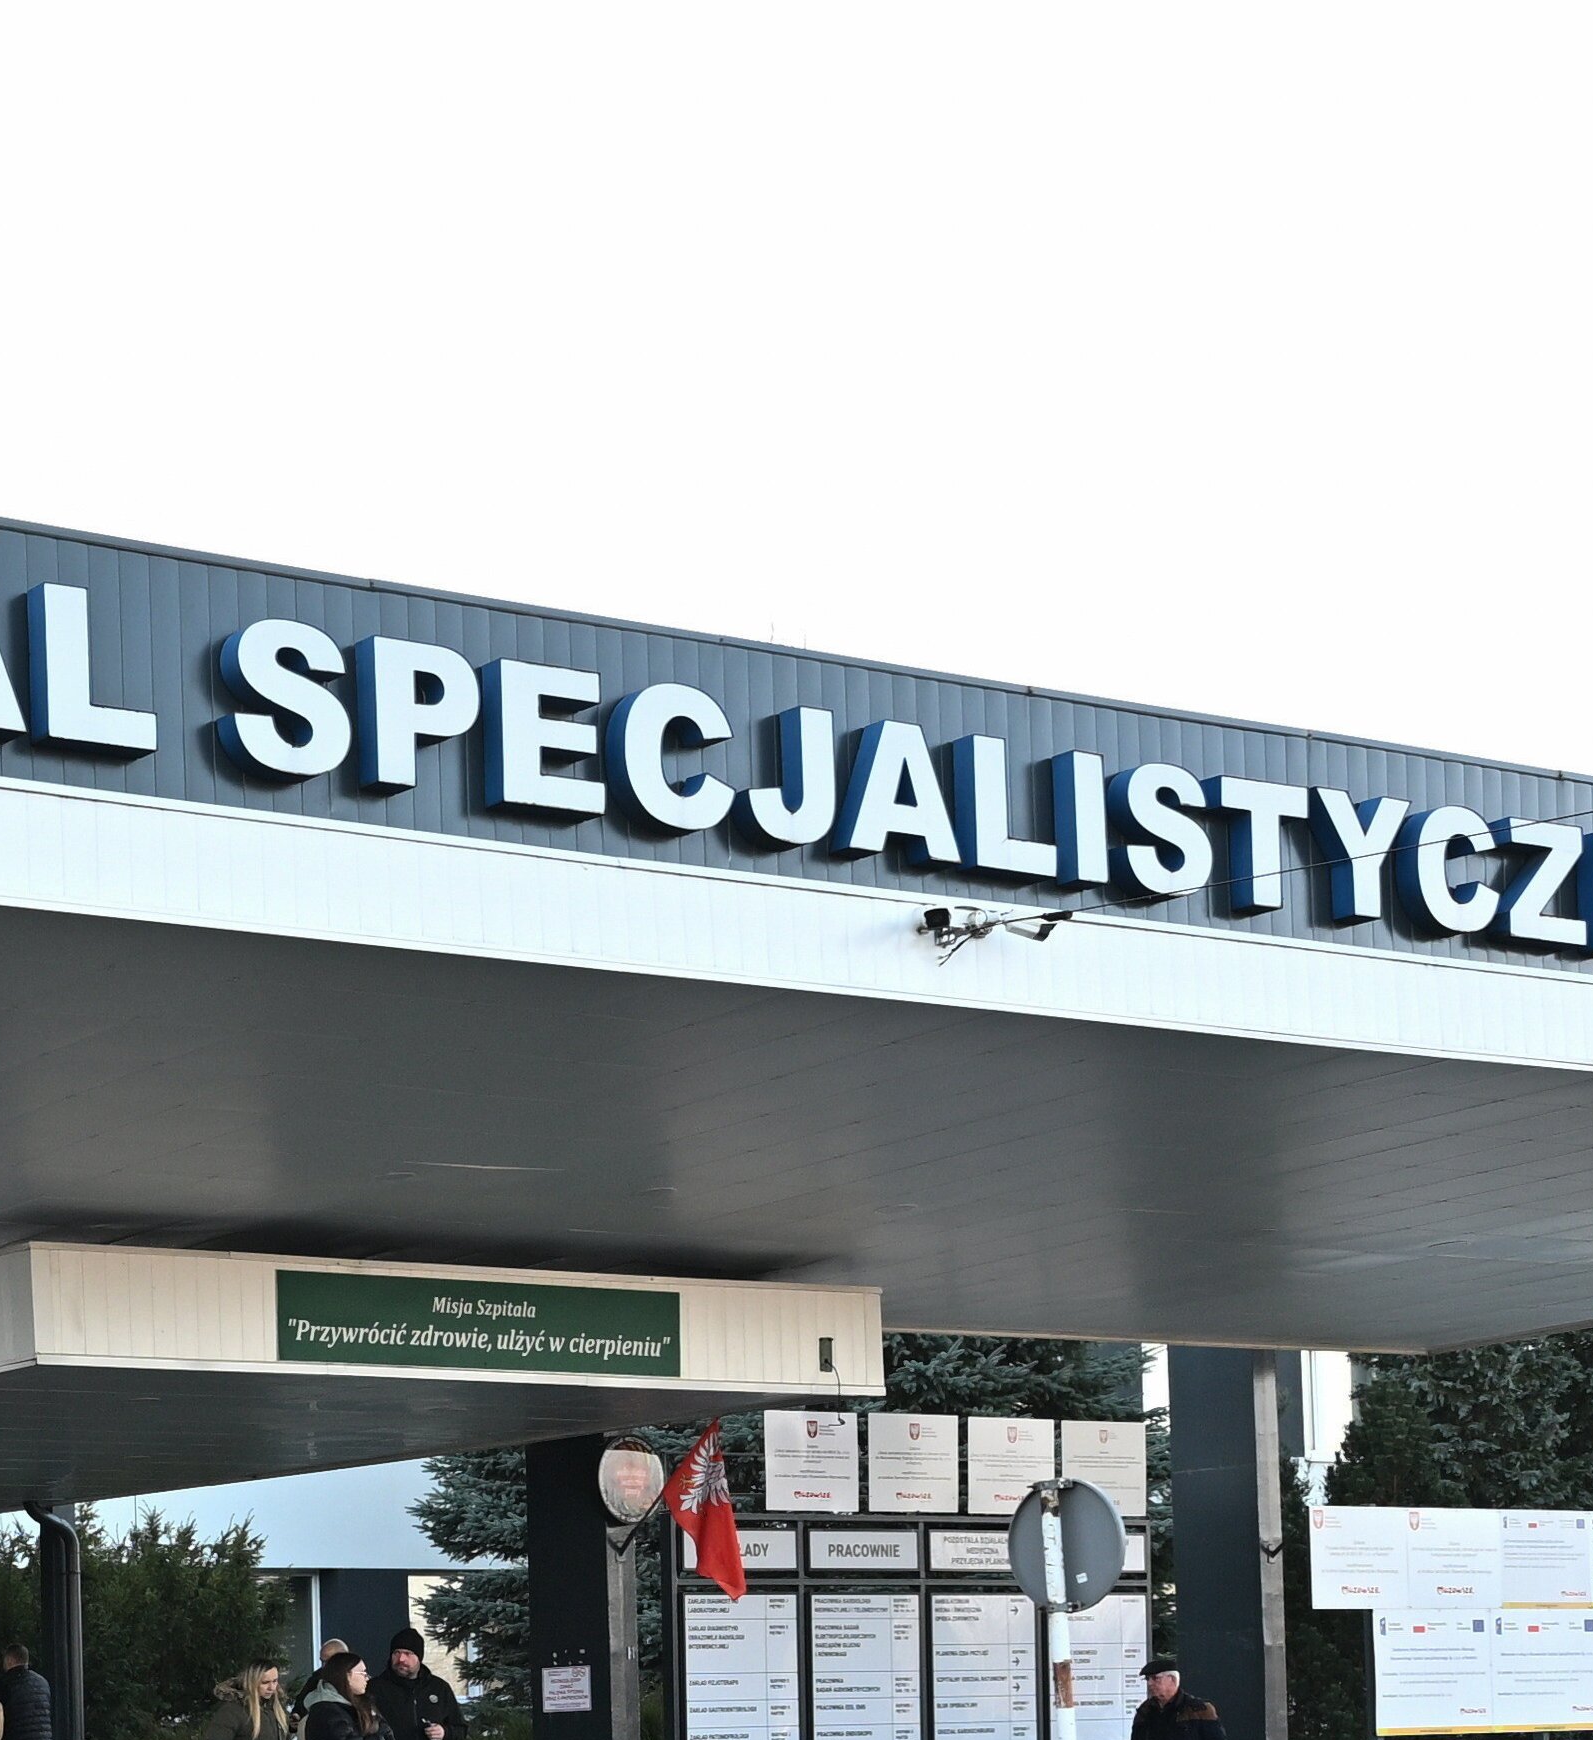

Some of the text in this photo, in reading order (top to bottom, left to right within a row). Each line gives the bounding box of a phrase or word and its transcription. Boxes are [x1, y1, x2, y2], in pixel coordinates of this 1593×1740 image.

[432, 1297, 536, 1320] Misja Szpitala
[288, 1318, 670, 1360] "Przywrócić zdrowie, ulżyć w cierpieniu"
[828, 1544, 900, 1557] PRACOWNIE
